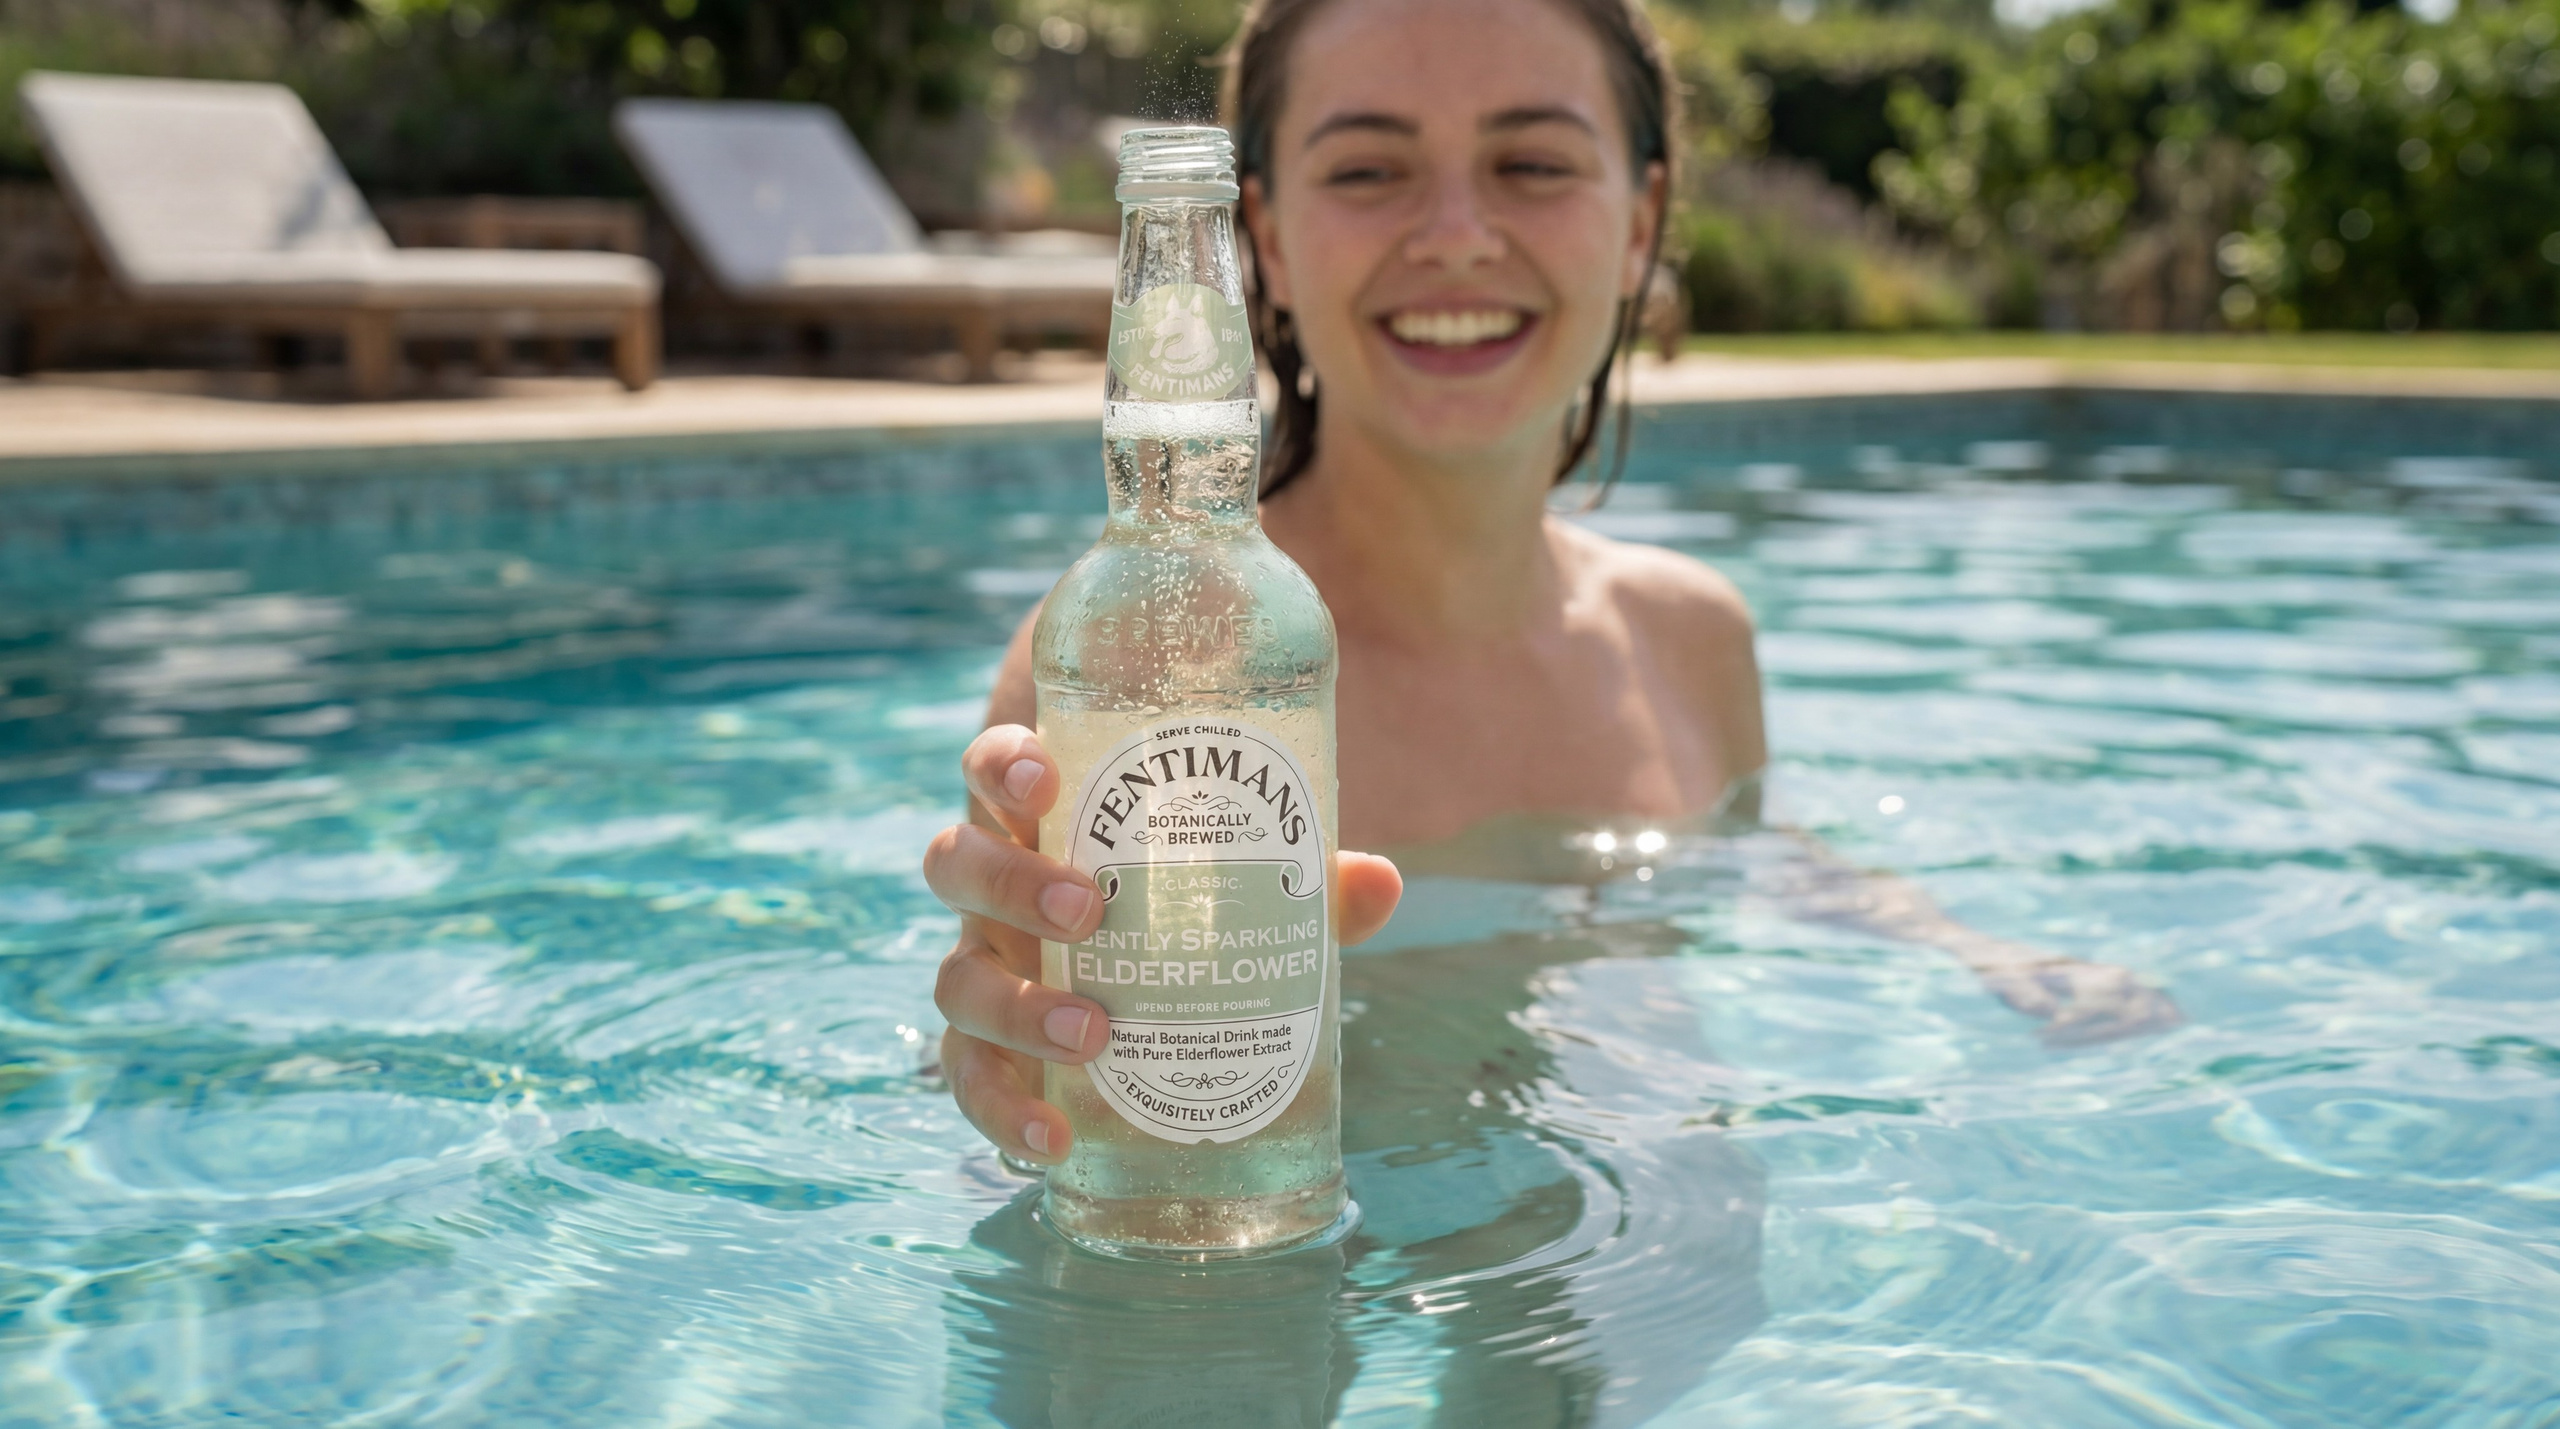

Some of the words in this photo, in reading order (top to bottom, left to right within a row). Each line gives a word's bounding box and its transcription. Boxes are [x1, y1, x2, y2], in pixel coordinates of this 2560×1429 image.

[1156, 727, 1191, 741] SERVE
[1194, 726, 1242, 738] CHILLED
[1089, 746, 1307, 850] FENTIMANS
[1148, 813, 1252, 828] BOTANICALLY
[1168, 831, 1234, 845] BREWED
[1181, 919, 1318, 951] SPARKLING
[1076, 948, 1317, 986] ELDERFLOWER
[1135, 1002, 1173, 1013] UPEND
[1176, 1003, 1220, 1013] BEFORE
[1223, 998, 1271, 1012] POURING
[1111, 1029, 1155, 1044] Natural
[1160, 1031, 1220, 1044] Botanical
[1224, 1028, 1259, 1043] Drink
[1262, 1024, 1292, 1039] made
[1113, 1046, 1140, 1060] with
[1143, 1048, 1173, 1061] Pure
[1176, 1047, 1249, 1060] Elderflower
[1253, 1040, 1292, 1056] Extract
[1126, 1082, 1214, 1121] EXQUISITELY
[1219, 1080, 1278, 1118] CRAFTED
